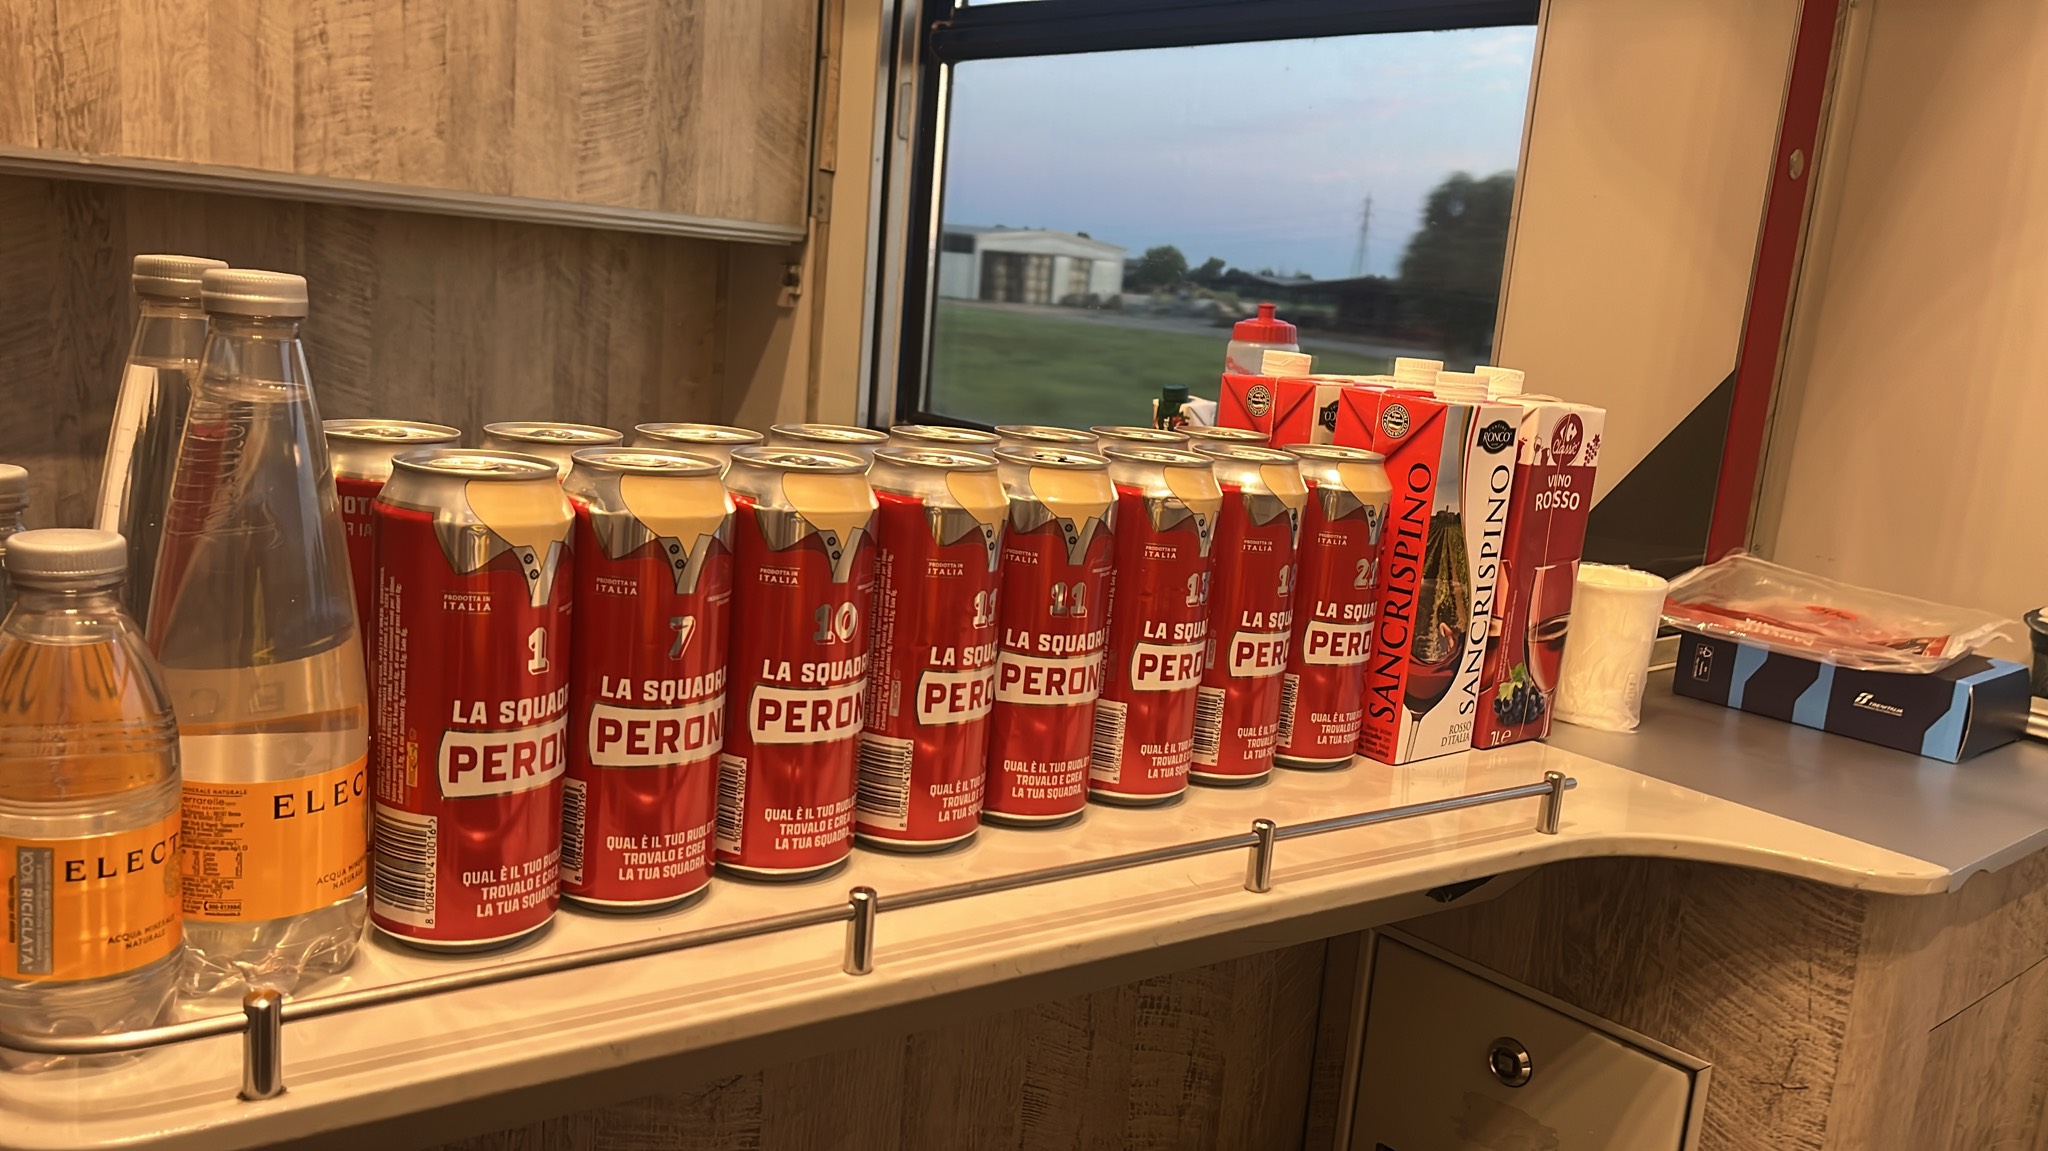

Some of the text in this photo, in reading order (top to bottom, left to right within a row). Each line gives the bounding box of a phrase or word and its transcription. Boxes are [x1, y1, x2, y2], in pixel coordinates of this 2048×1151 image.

[1482, 432, 1511, 443] RONCO
[1547, 474, 1572, 488] VINO
[1535, 490, 1580, 512] ROSSO
[1243, 544, 1272, 552] ITALIA
[1318, 538, 1347, 546] ITALIA
[1005, 553, 1038, 565] ITALIA
[1144, 551, 1176, 559] ITALIA
[759, 574, 798, 585] ITALIA
[760, 567, 790, 577] PRODOTTA
[928, 568, 963, 576] ITALIA
[595, 583, 638, 596] ITALIA
[596, 577, 629, 587] PRODOTTA
[1459, 465, 1510, 715] SANCRISPINO
[444, 594, 482, 602] PRODOTTA
[1050, 581, 1087, 618] 11
[1369, 463, 1431, 723] SANCRISPINO
[443, 601, 491, 611] ITALIA
[1315, 601, 1337, 618] LA
[813, 602, 859, 645] 10
[1241, 610, 1263, 628] LA
[668, 615, 696, 660] 7
[1144, 620, 1167, 639] LA
[1005, 628, 1029, 649] LA
[528, 627, 549, 675] 1
[930, 646, 955, 666] LA
[762, 659, 791, 682] LA
[601, 675, 632, 700] LA
[452, 700, 487, 724] LA
[1311, 713, 1331, 724] QUAL
[1321, 722, 1351, 734] TROVALO
[1449, 721, 1472, 735] ROSSO
[1317, 736, 1327, 744] LA
[1329, 735, 1342, 744] TUA
[1441, 733, 1470, 747] D'ITALIA
[1140, 744, 1162, 756] QUAL
[1004, 760, 1029, 773] QUAL
[1031, 760, 1036, 773] È
[1038, 763, 1047, 773] IL
[1049, 761, 1066, 773] TUO
[1152, 755, 1183, 766] TROVALO
[1016, 771, 1082, 786] TROVALO CREA
[1148, 769, 1158, 778] LA
[1160, 767, 1174, 778] TUA
[930, 780, 969, 797] QUAL È IL
[1012, 787, 1024, 798] LA
[1026, 787, 1045, 799] TUA
[942, 792, 976, 808] TROVALO
[765, 805, 834, 822] QUAL È IL TUO
[938, 810, 950, 822] LA
[952, 809, 967, 820] TUA
[780, 812, 850, 835] TROVALO E CREA
[575, 792, 586, 883] 8 008440 410016
[607, 836, 638, 851] QUAL
[641, 834, 648, 849] È
[651, 836, 661, 849] IL
[664, 832, 685, 845] TUO
[775, 838, 789, 850] LA
[792, 836, 812, 849] TUA
[426, 828, 436, 868] 410016
[623, 839, 706, 866] TROVALO E CREA
[316, 868, 347, 886] ACQUA
[462, 858, 541, 887] QUAL È IL TUO
[618, 868, 634, 881] LA
[637, 866, 660, 881] TUA
[425, 872, 435, 911] 008440
[481, 878, 534, 901] TROVALO
[535, 876, 541, 888] E
[476, 904, 493, 918] LA
[496, 901, 520, 915] TUA
[108, 912, 175, 945] ACQUA MINERALE
[126, 928, 166, 950] NATURALE
